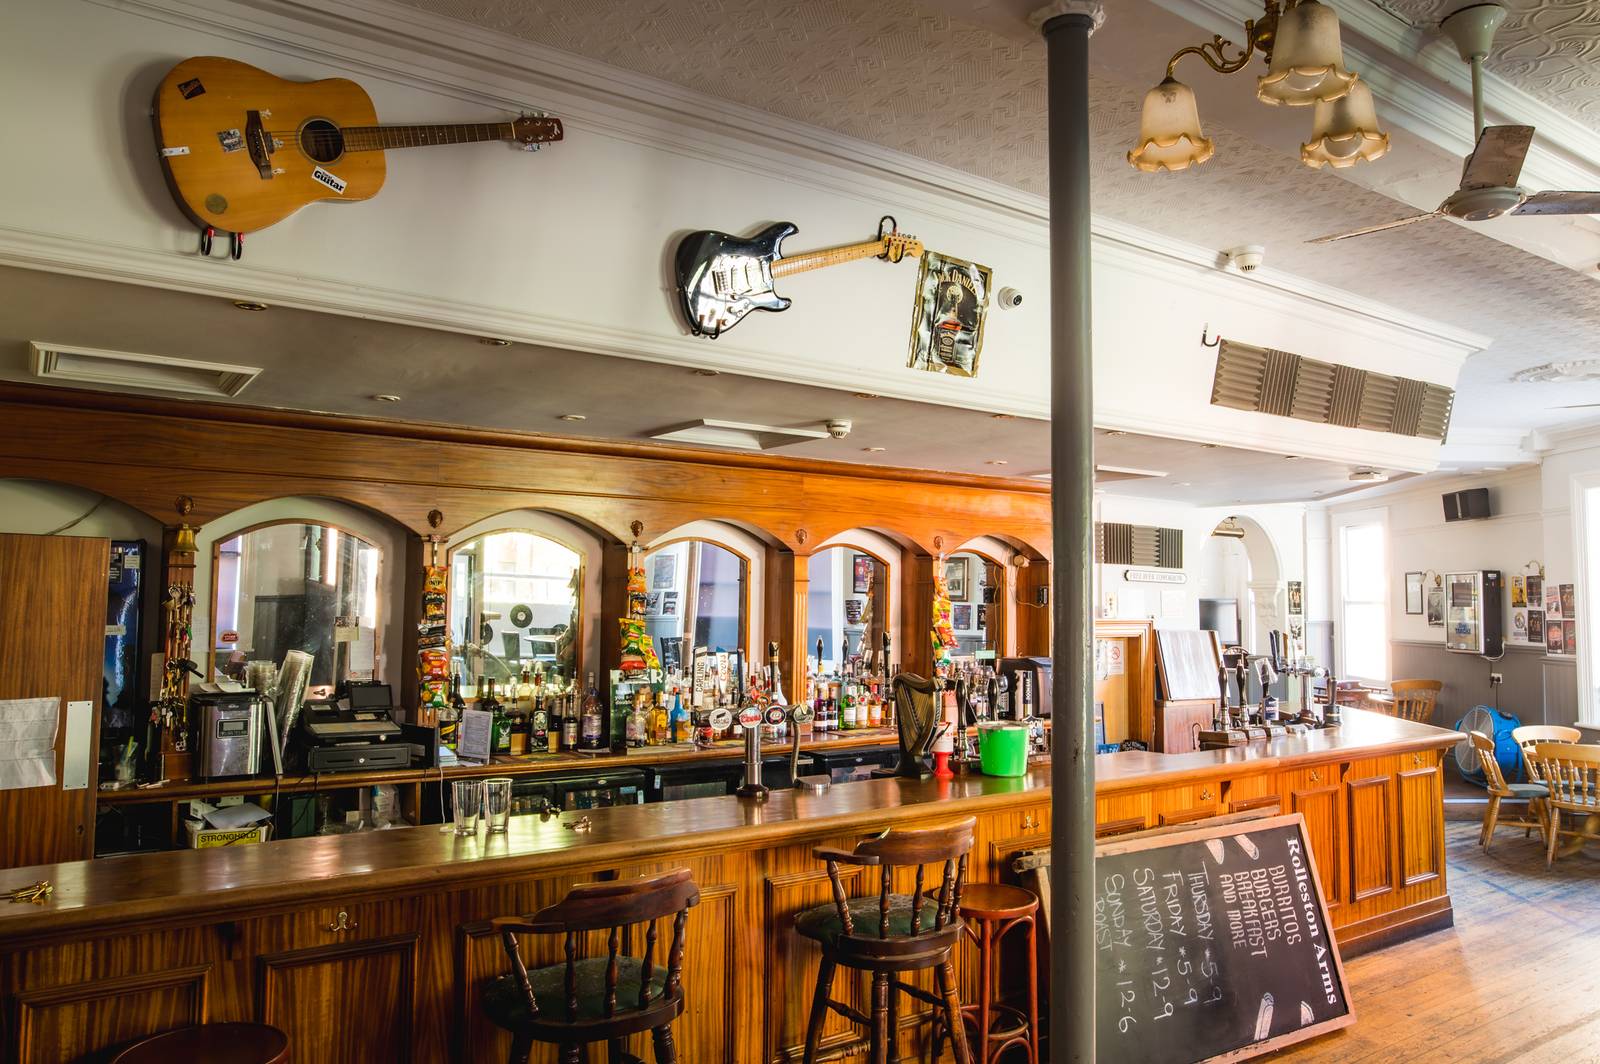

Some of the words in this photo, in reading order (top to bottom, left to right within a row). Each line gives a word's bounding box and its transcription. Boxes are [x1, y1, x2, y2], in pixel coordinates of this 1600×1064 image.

[314, 170, 344, 191] Guitar
[696, 662, 705, 693] CARLING
[200, 832, 257, 843] STRONGHOLD
[1105, 873, 1132, 948] SUNDAY
[1132, 868, 1166, 951] SATURDAY
[1162, 870, 1187, 937] FRIDAY
[1187, 861, 1215, 941] THURSDAY
[1218, 874, 1237, 904] AND
[1233, 871, 1268, 959] BREAKFAST
[1251, 868, 1282, 941] BURGERS
[1268, 864, 1301, 946] BURRITOS
[1286, 837, 1319, 938] Rolleston
[1313, 943, 1337, 1005] Arms
